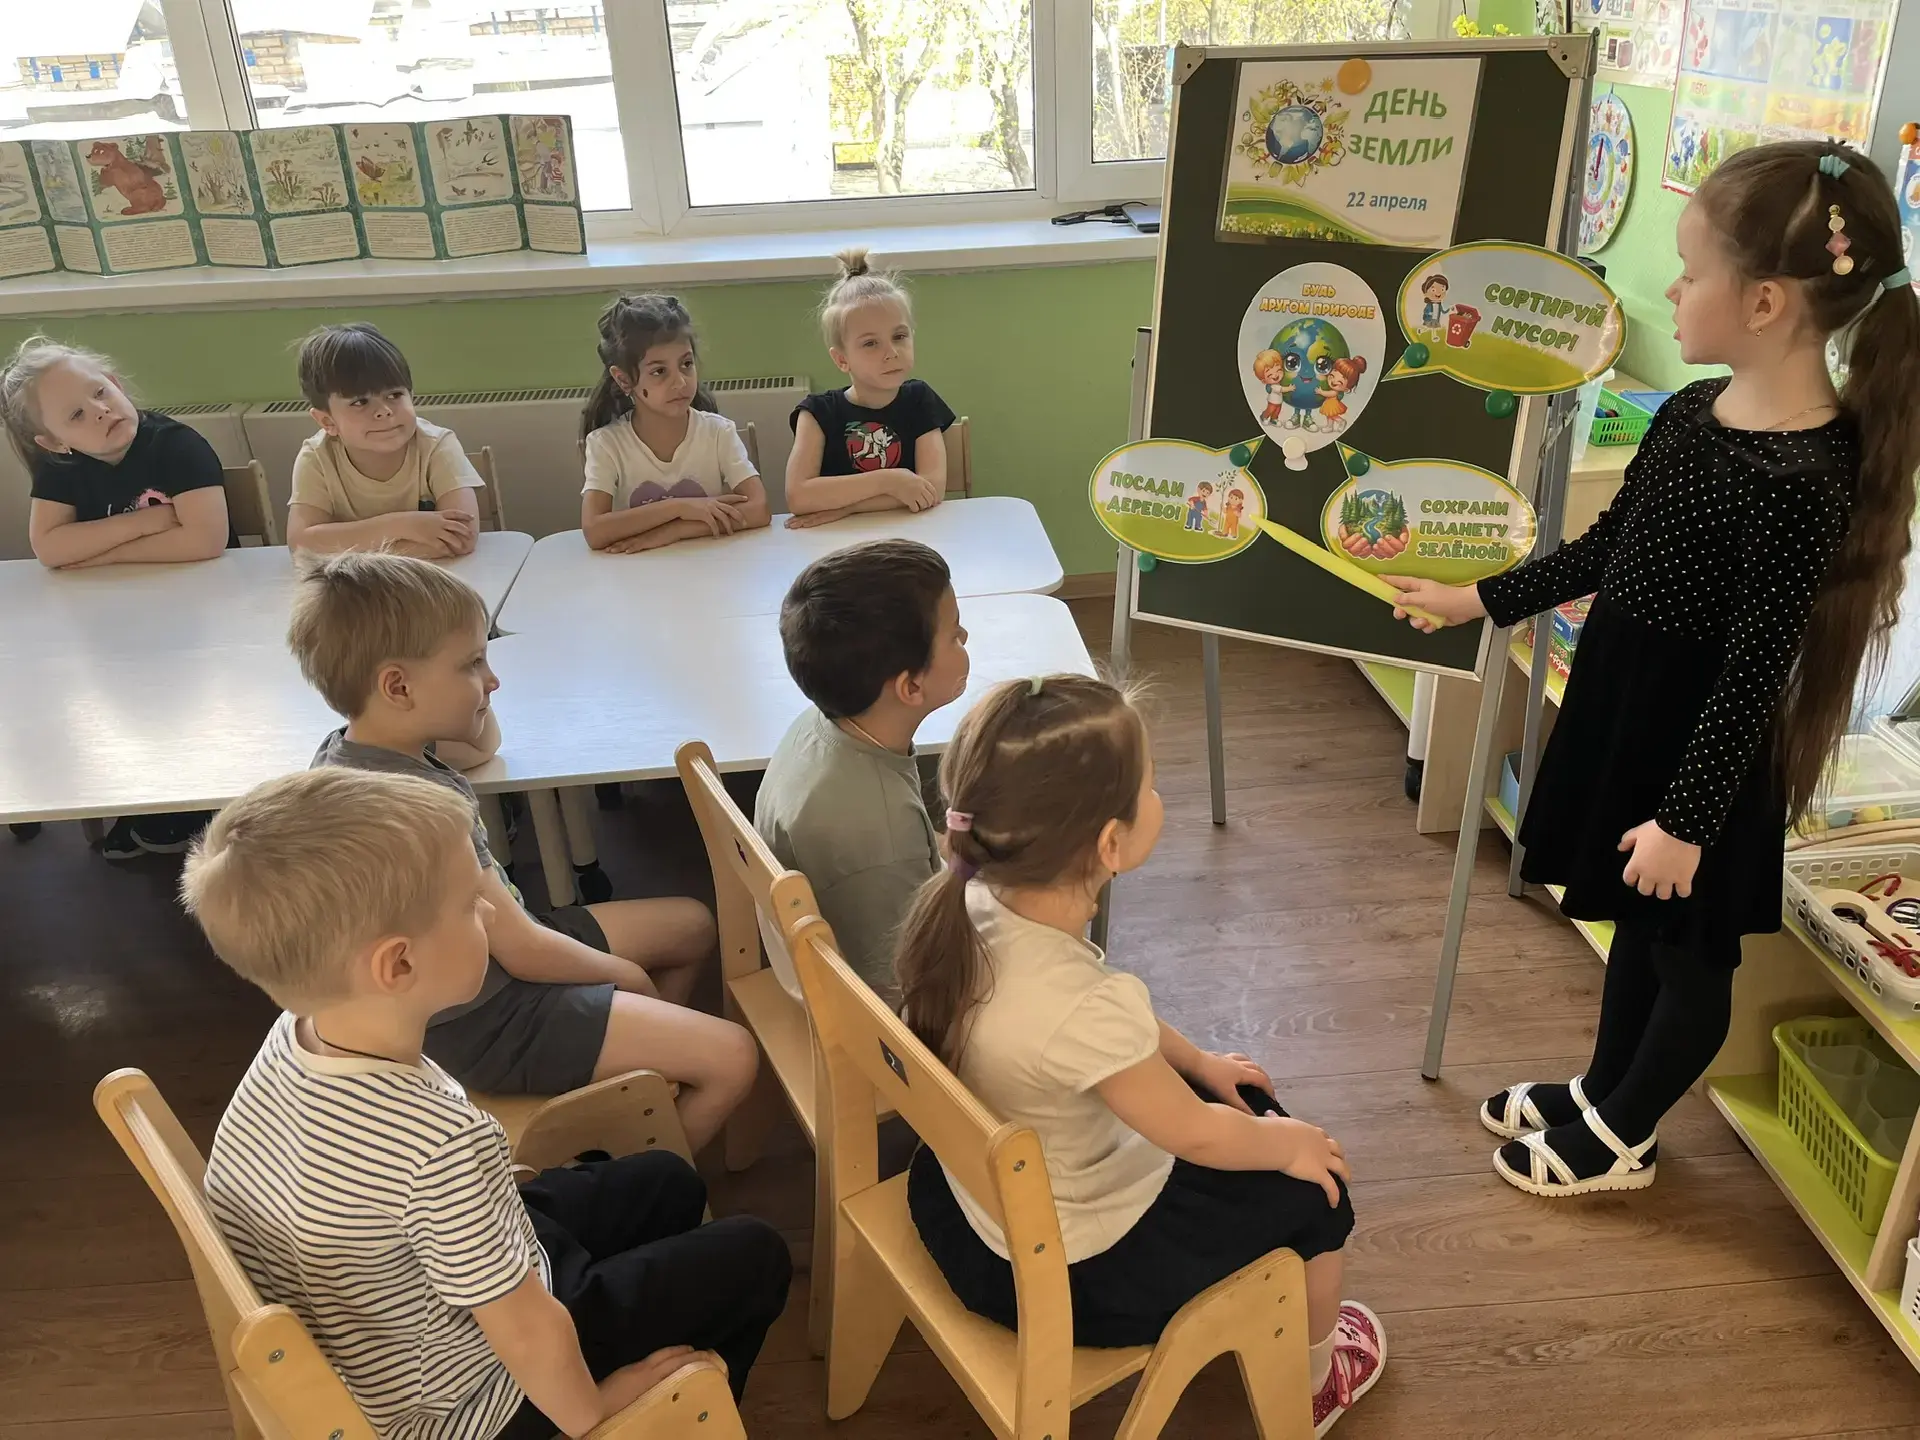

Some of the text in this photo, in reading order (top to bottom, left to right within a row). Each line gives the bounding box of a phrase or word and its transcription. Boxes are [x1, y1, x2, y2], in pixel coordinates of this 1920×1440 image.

[1363, 88, 1448, 124] ДЕНЬ
[1348, 133, 1454, 166] ЗЕМЛИ
[1346, 191, 1428, 212] 22 апреля
[1302, 283, 1336, 298] БУДЬ
[1259, 297, 1376, 319] ДРУГОМ ПРИРОДЕ
[1484, 283, 1608, 328] СОРТИРУЙ
[1491, 316, 1580, 352] МУСОР!
[1109, 471, 1185, 498] ПОСАДИ
[1106, 495, 1182, 520] ДЕРЕВО!
[1420, 499, 1509, 516] СОХРАНИ
[1419, 520, 1509, 538] ПЛАНЕТУ
[1417, 539, 1508, 560] ЗЕЛЁНОЙ!
